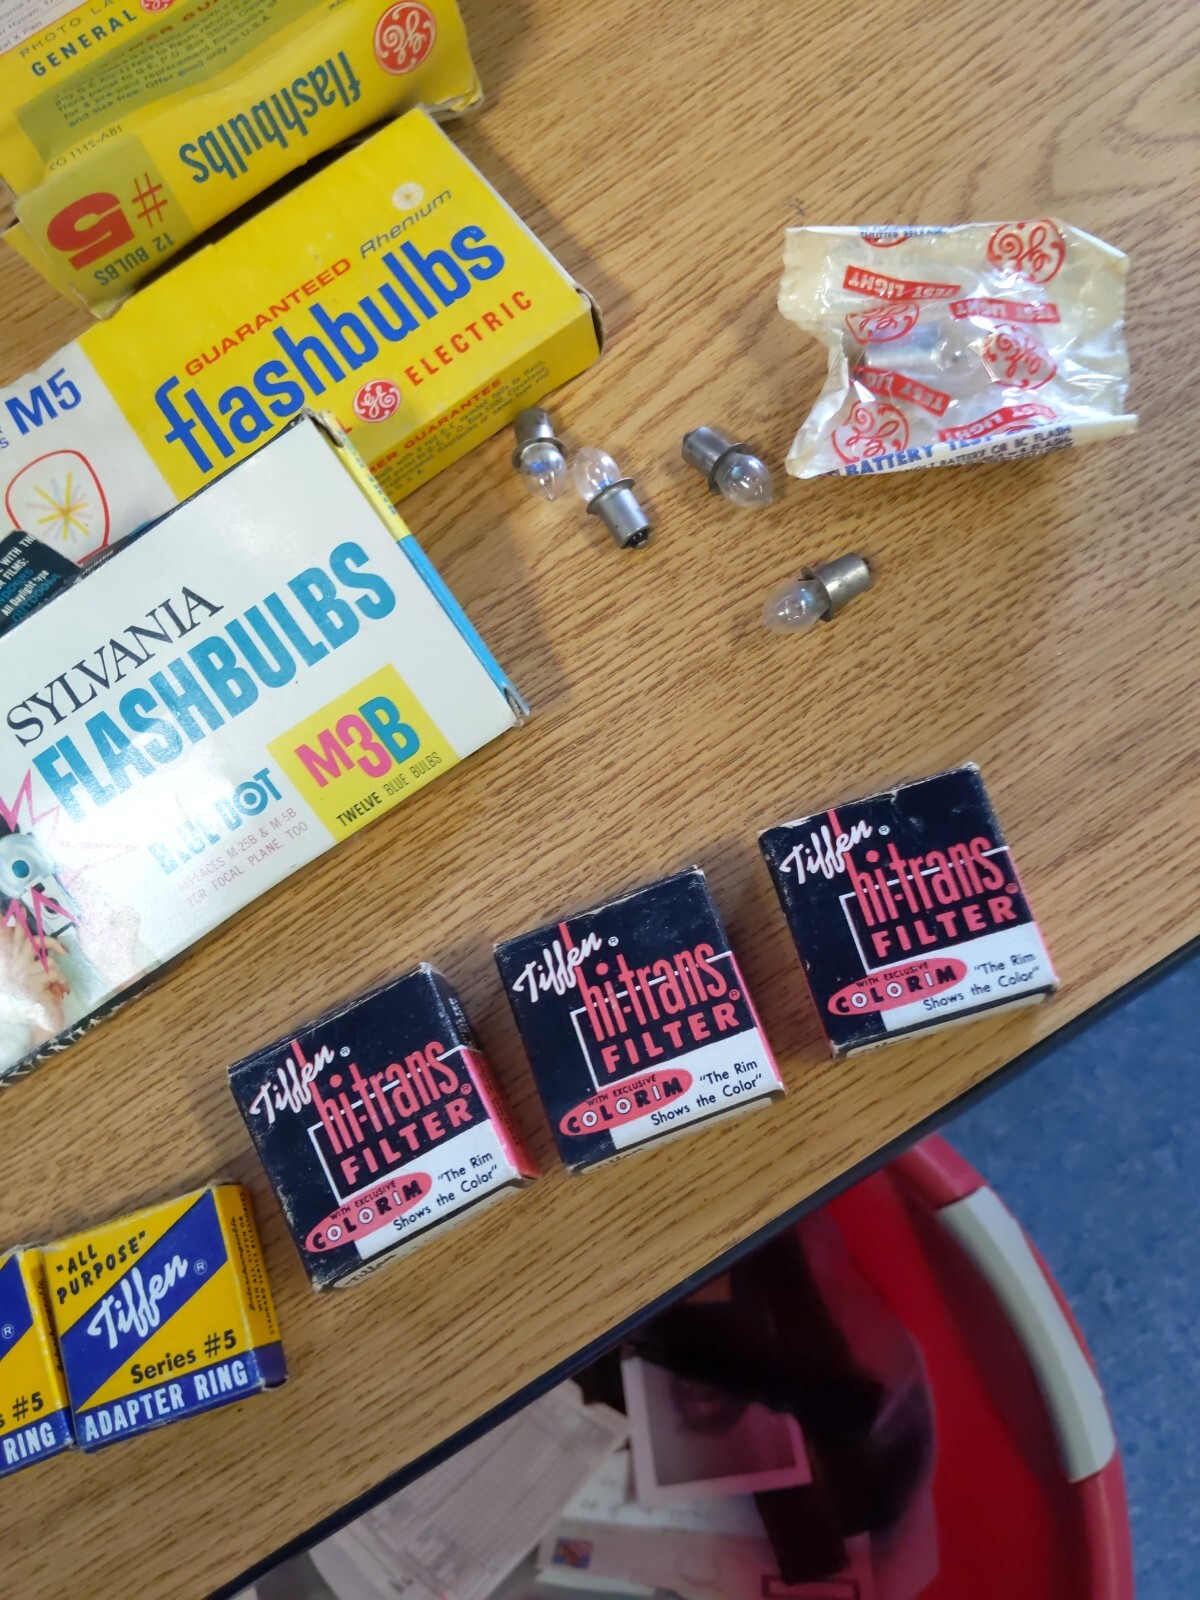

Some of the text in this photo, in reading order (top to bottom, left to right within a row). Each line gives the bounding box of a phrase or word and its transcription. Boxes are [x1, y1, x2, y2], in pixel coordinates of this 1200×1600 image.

[20, 17, 81, 58] PHOTO
[31, 9, 137, 77] GENERAL
[178, 51, 362, 184] flashbulbs
[358, 189, 452, 259] Rhenium
[94, 231, 175, 287] 12 BULBS
[848, 271, 905, 297] LIGHT
[185, 258, 352, 377] GUARANTEED
[404, 290, 532, 386] ELECTRIC
[154, 225, 505, 474] flashbulbs
[5, 368, 82, 436] M5
[404, 379, 502, 449] GUARANTEE
[846, 444, 934, 476] BATTERY
[0, 547, 22, 566] WITH
[3, 558, 30, 580] FILMS:
[2, 605, 14, 617] All
[9, 580, 37, 606] Daylight
[5, 585, 224, 747] SYLVANIA
[31, 541, 397, 824] FLASHBULBS
[293, 696, 420, 788] M3B
[215, 767, 283, 832] DOT
[336, 751, 443, 827] TWELVE BLUE BULBS
[210, 865, 245, 892] FOCAL
[285, 821, 309, 844] TOO
[226, 834, 258, 860] M-25B
[779, 820, 873, 884] Tiffen
[844, 836, 1005, 926] hi-trans
[871, 896, 1018, 958] FILTER
[512, 932, 602, 1003] Tiffen
[836, 965, 957, 1013] COLORIM
[856, 961, 929, 988] WITH EXCLUSIVE
[1010, 952, 1035, 968] Rim
[575, 943, 727, 1041] hi-trans
[923, 991, 964, 1011] Shows
[970, 980, 991, 996] the
[601, 1002, 740, 1074] FILTER
[734, 1059, 758, 1076] Rim
[250, 1045, 334, 1123] Tiffen
[309, 1041, 458, 1155] hi-trans
[567, 1077, 683, 1133] COLORIM
[587, 1075, 656, 1106] WITH EXCLUSIVE
[651, 1104, 690, 1126] Shows
[697, 1091, 716, 1108] the
[340, 1097, 474, 1186] FILTER
[470, 1151, 493, 1169] Rim
[238, 1216, 245, 1227] OR
[240, 1192, 255, 1248] ACCESSORIES
[312, 1179, 422, 1250] COLORIM
[330, 1181, 396, 1220] WITH EXCLUSIVE
[393, 1205, 431, 1231] Shows
[436, 1191, 455, 1207] the
[253, 1253, 263, 1284] SERIES
[87, 1255, 188, 1349] Tiffen
[255, 1287, 263, 1311] WITH
[130, 1329, 237, 1384] Series #5
[13, 1391, 44, 1421] #5
[85, 1360, 248, 1441] ADAPTER RING
[4, 1422, 55, 1464] RING
